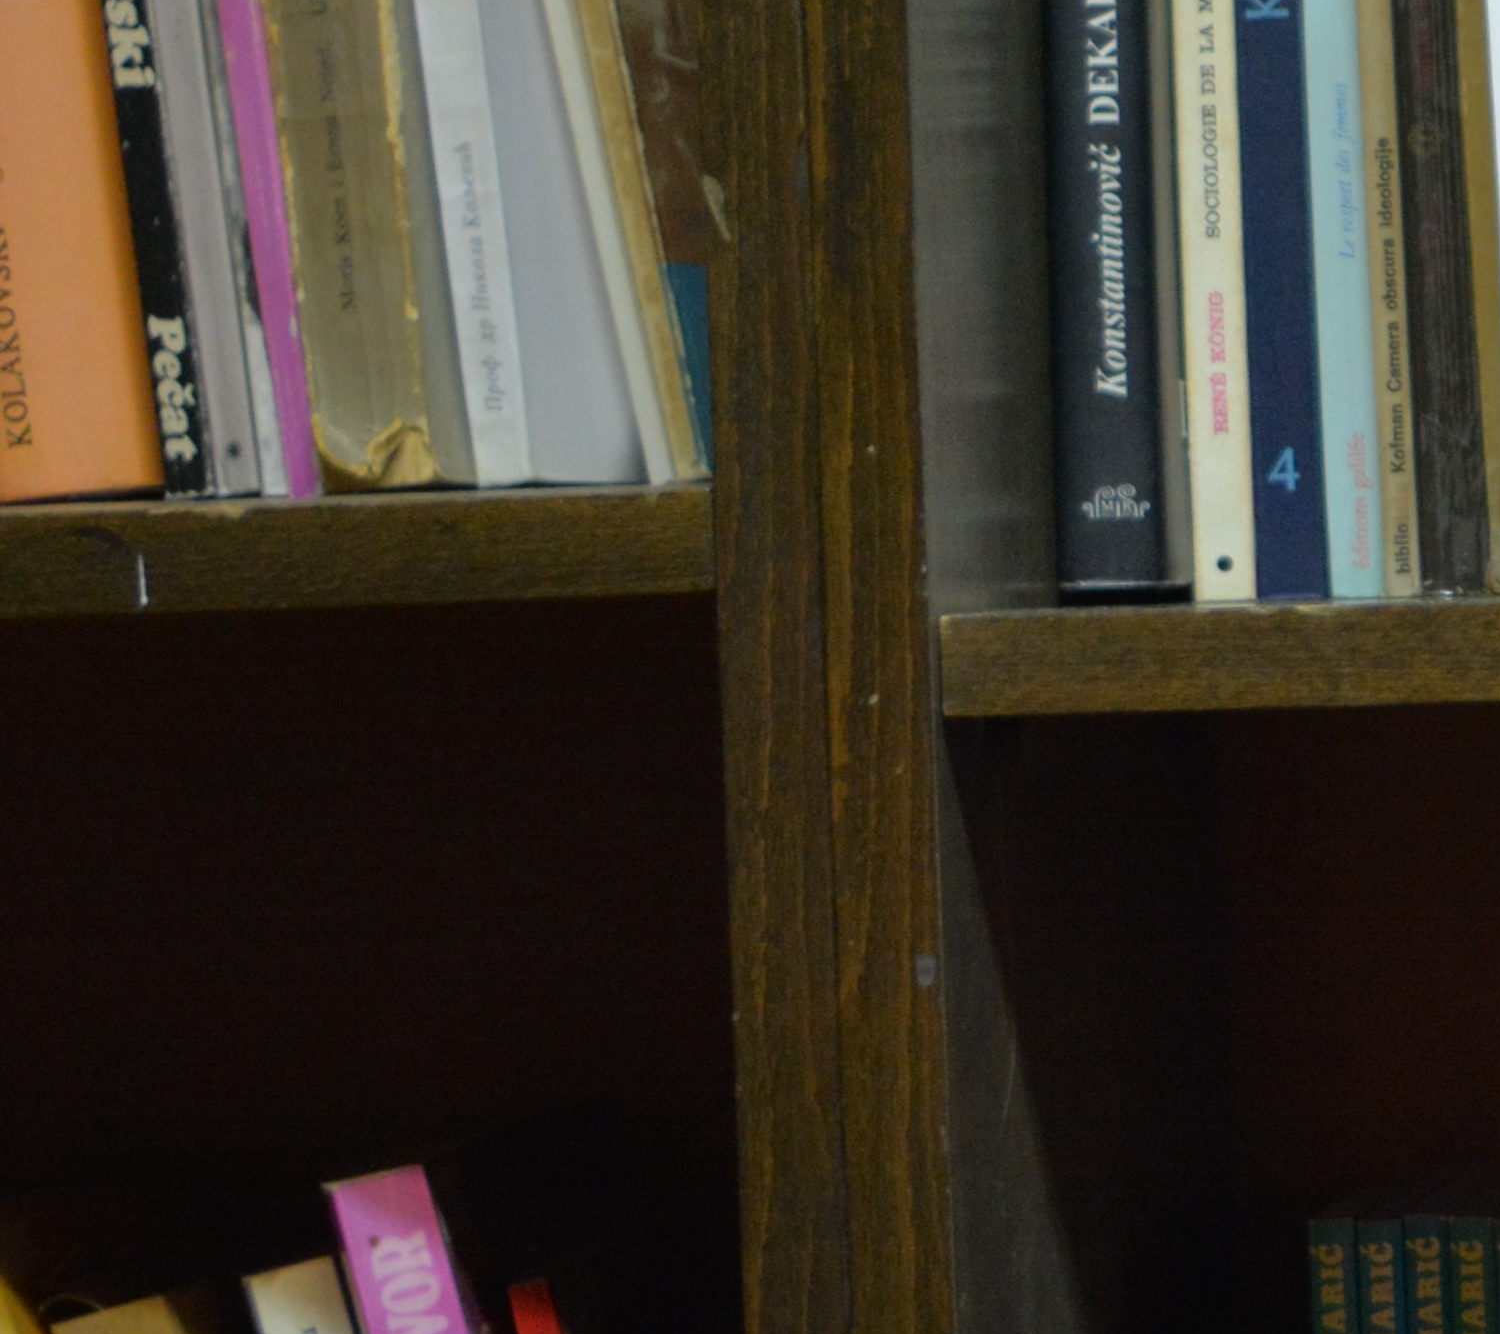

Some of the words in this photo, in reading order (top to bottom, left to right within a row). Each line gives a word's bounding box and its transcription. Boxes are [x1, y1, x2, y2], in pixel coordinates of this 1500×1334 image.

[1197, 22, 1216, 54] LA
[1199, 64, 1218, 98] DE
[1201, 103, 1222, 240] SOCIOLOGIE
[1373, 135, 1395, 228] ideologije
[1088, 143, 1128, 399] Konstantinović
[1379, 237, 1400, 313] obscura
[1206, 290, 1228, 363] KÖNIG
[1384, 320, 1403, 394] Camera
[147, 313, 197, 461] Pečat
[1208, 371, 1231, 436] RENÉ
[1267, 444, 1301, 493] 4
[1388, 402, 1407, 474] Kofman
